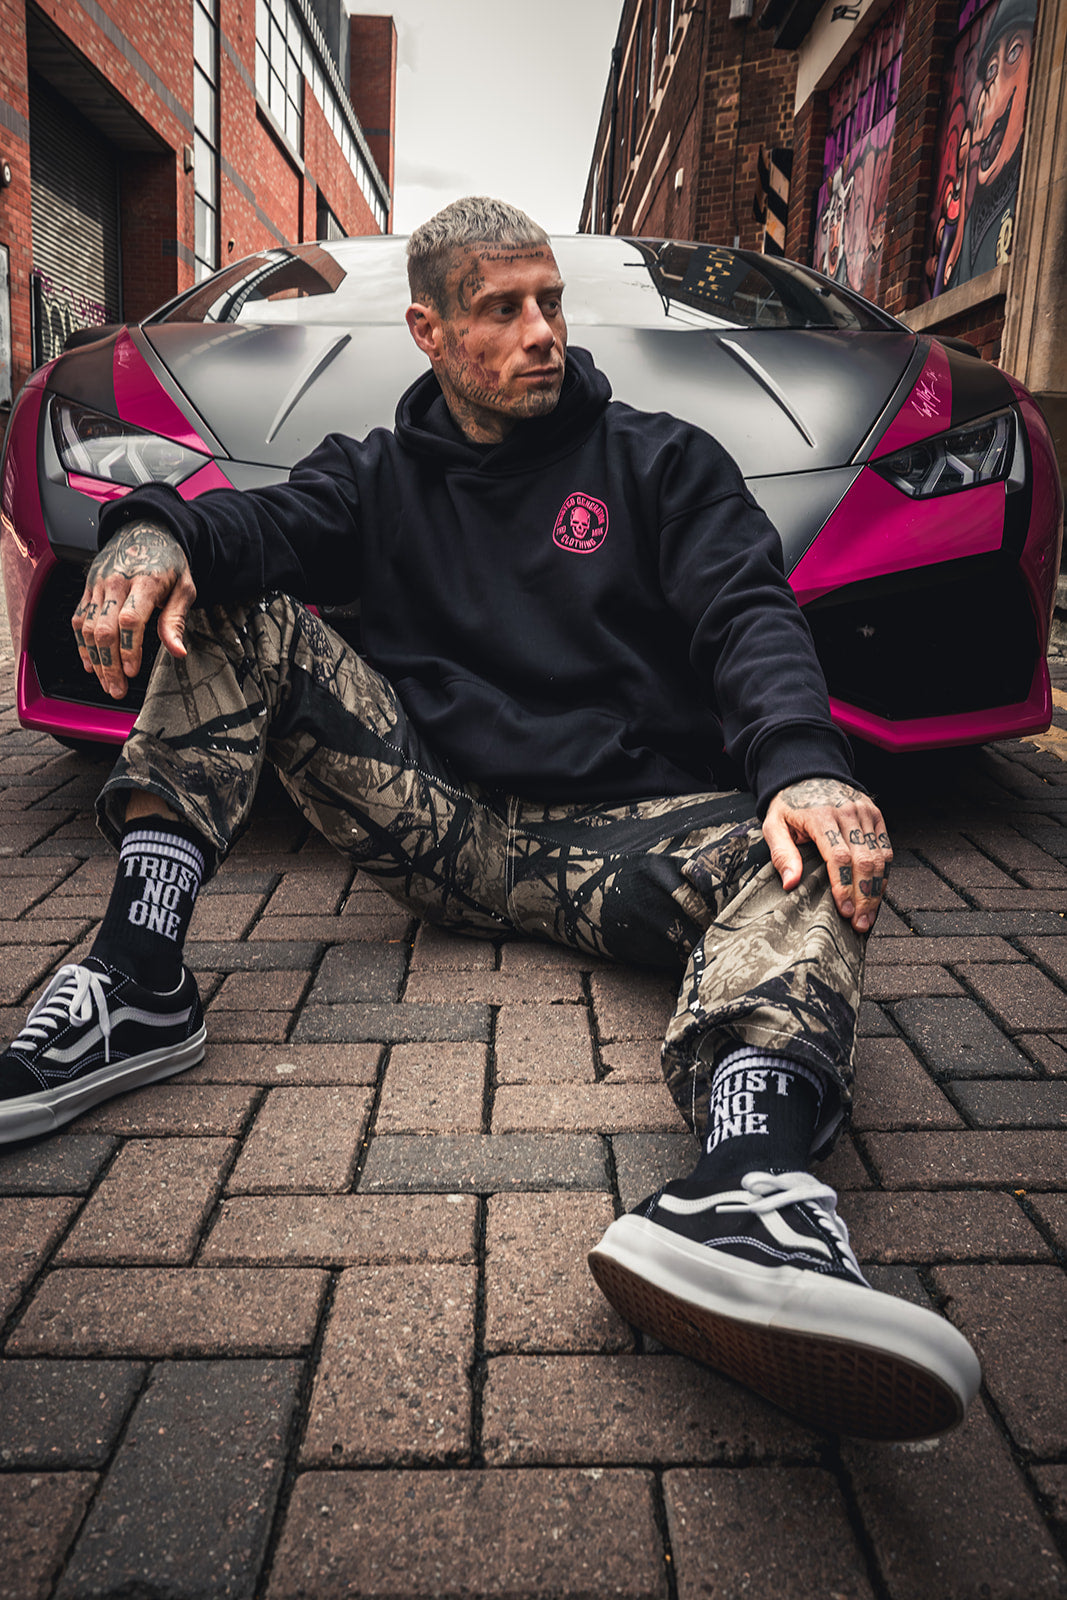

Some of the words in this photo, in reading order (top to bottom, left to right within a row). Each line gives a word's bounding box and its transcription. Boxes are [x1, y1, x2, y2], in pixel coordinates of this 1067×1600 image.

[561, 534, 597, 549] CLOTHING
[123, 855, 199, 902] TRUST
[141, 877, 182, 911] NO
[128, 899, 182, 942] ONE
[713, 1091, 756, 1128] NO
[706, 1113, 770, 1154] ONE
